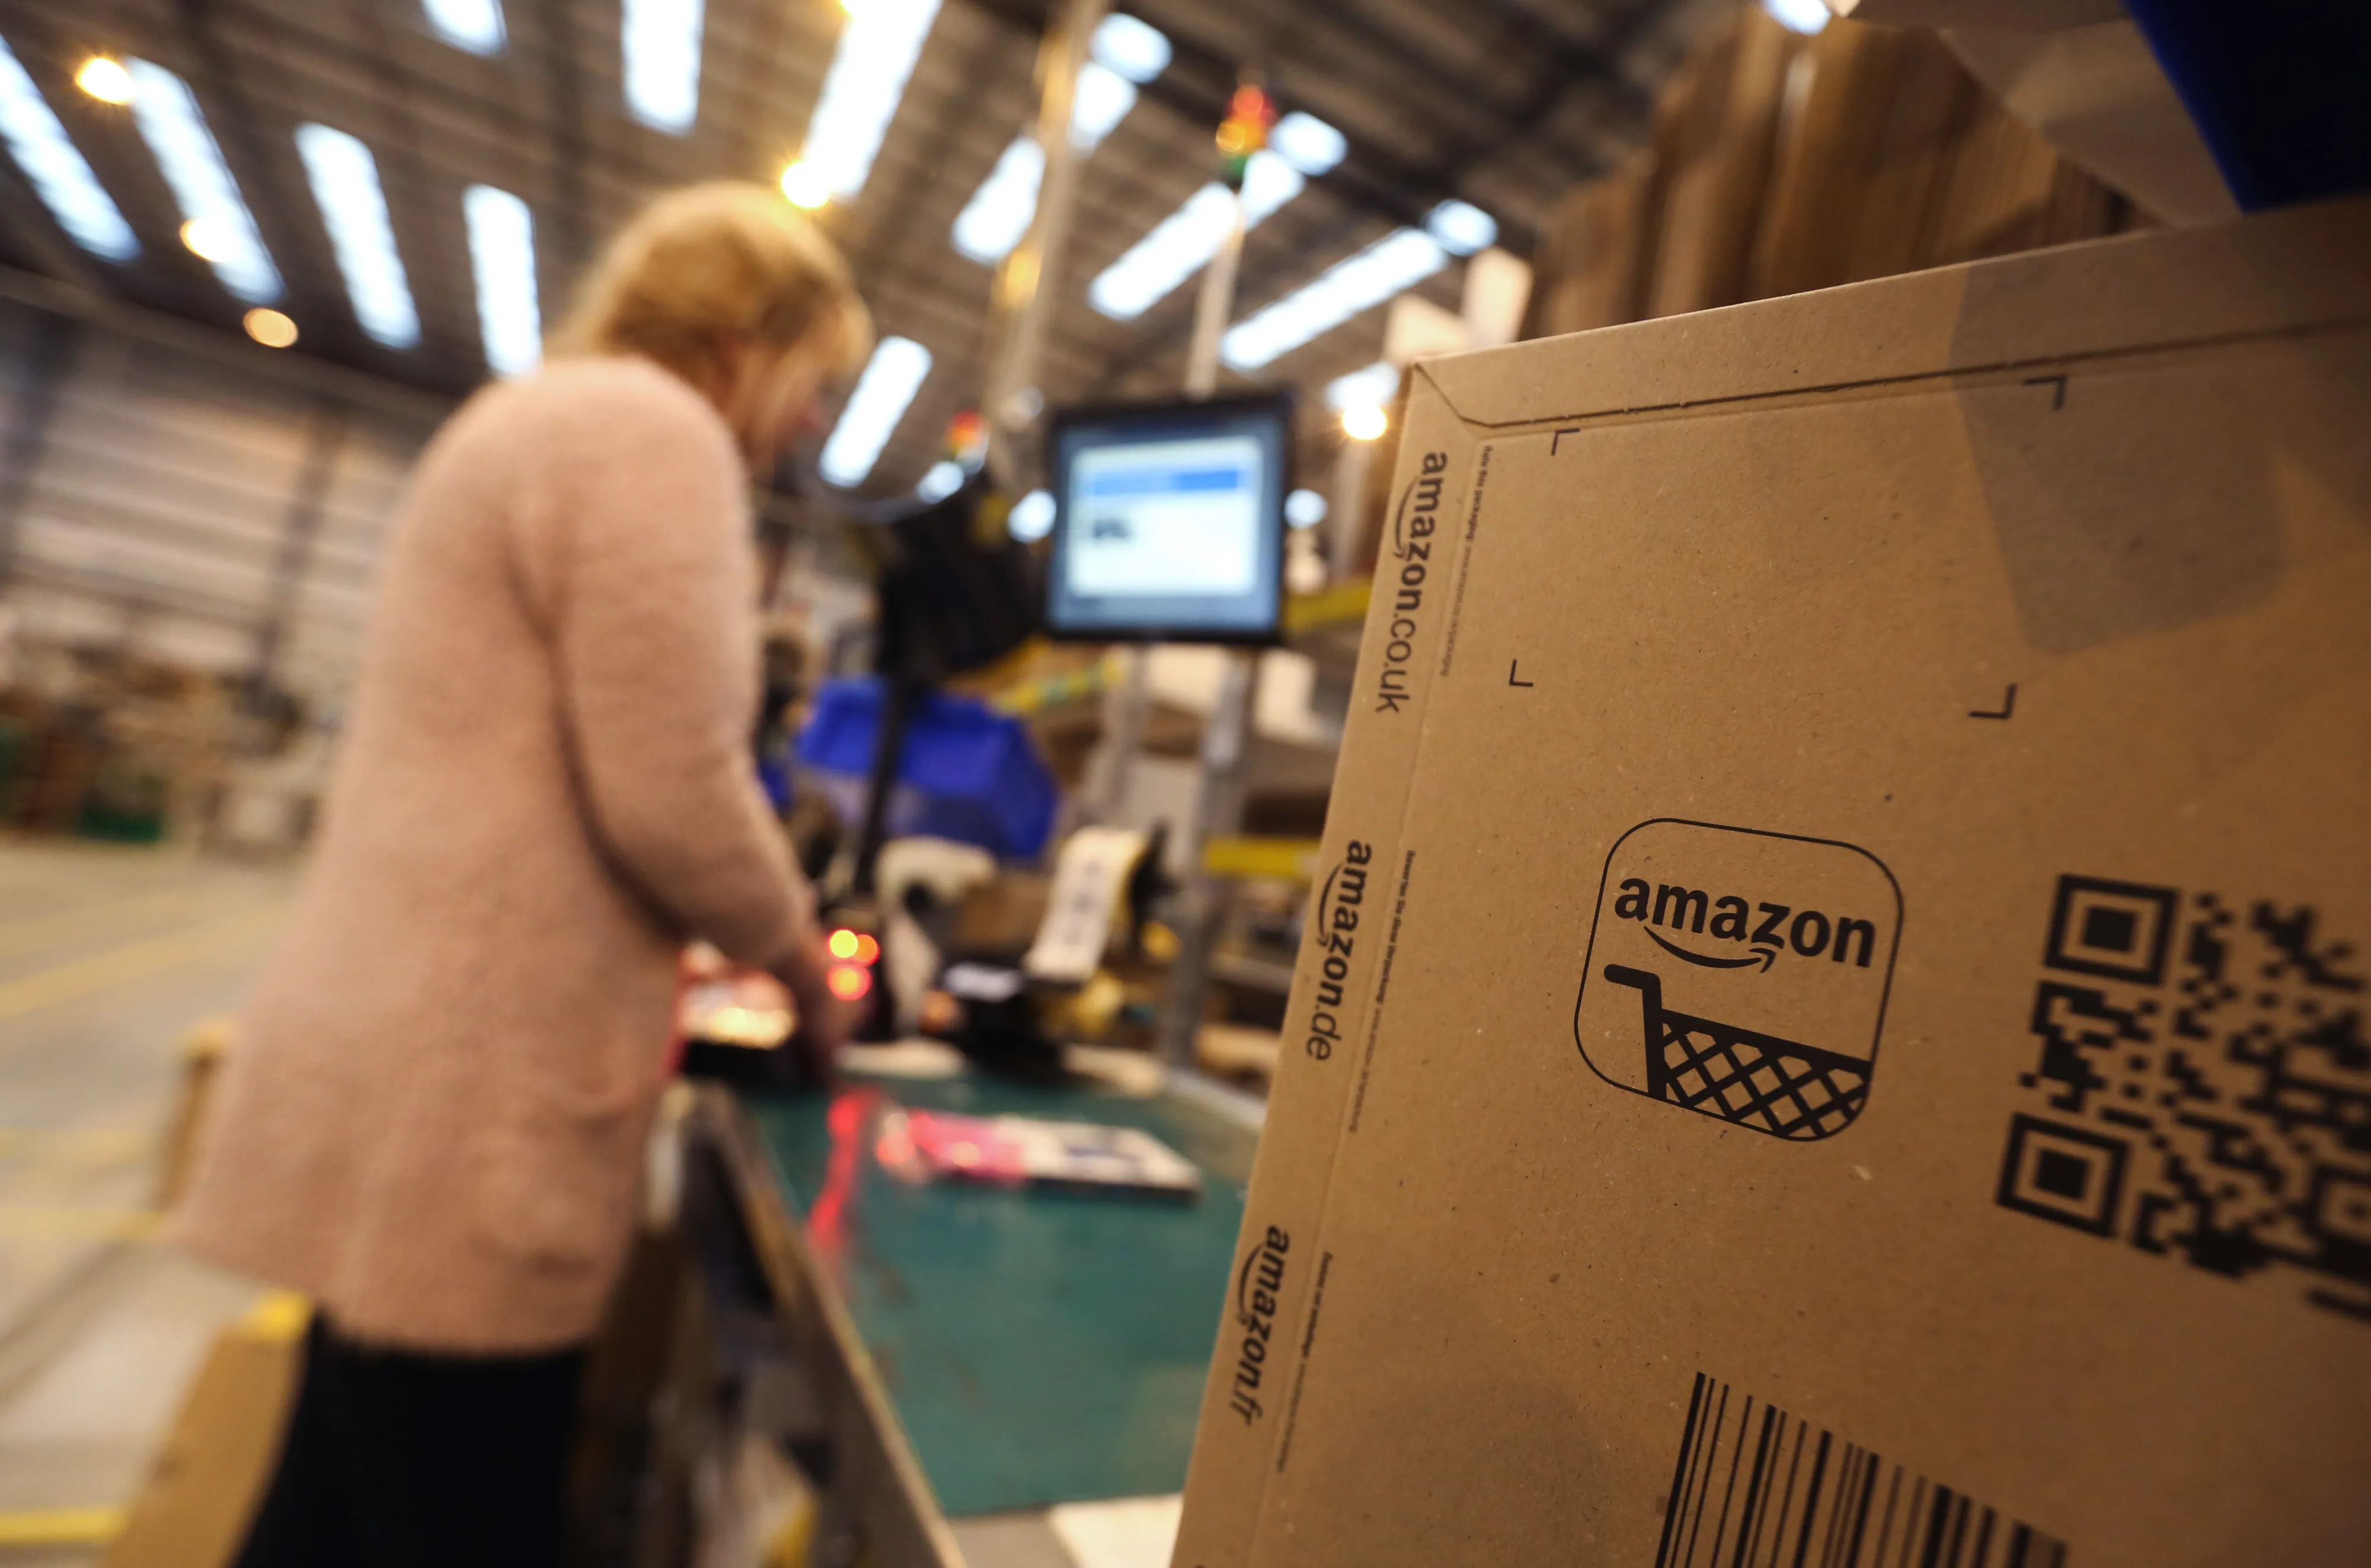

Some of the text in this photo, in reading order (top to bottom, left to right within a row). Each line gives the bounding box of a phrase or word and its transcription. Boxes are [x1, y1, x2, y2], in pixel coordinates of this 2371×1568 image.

[1375, 452, 1448, 713] amazon.co.uk
[1306, 840, 1372, 1061] amazon.de
[1615, 878, 1877, 968] amazon
[1229, 1225, 1290, 1426] amazon.fr
